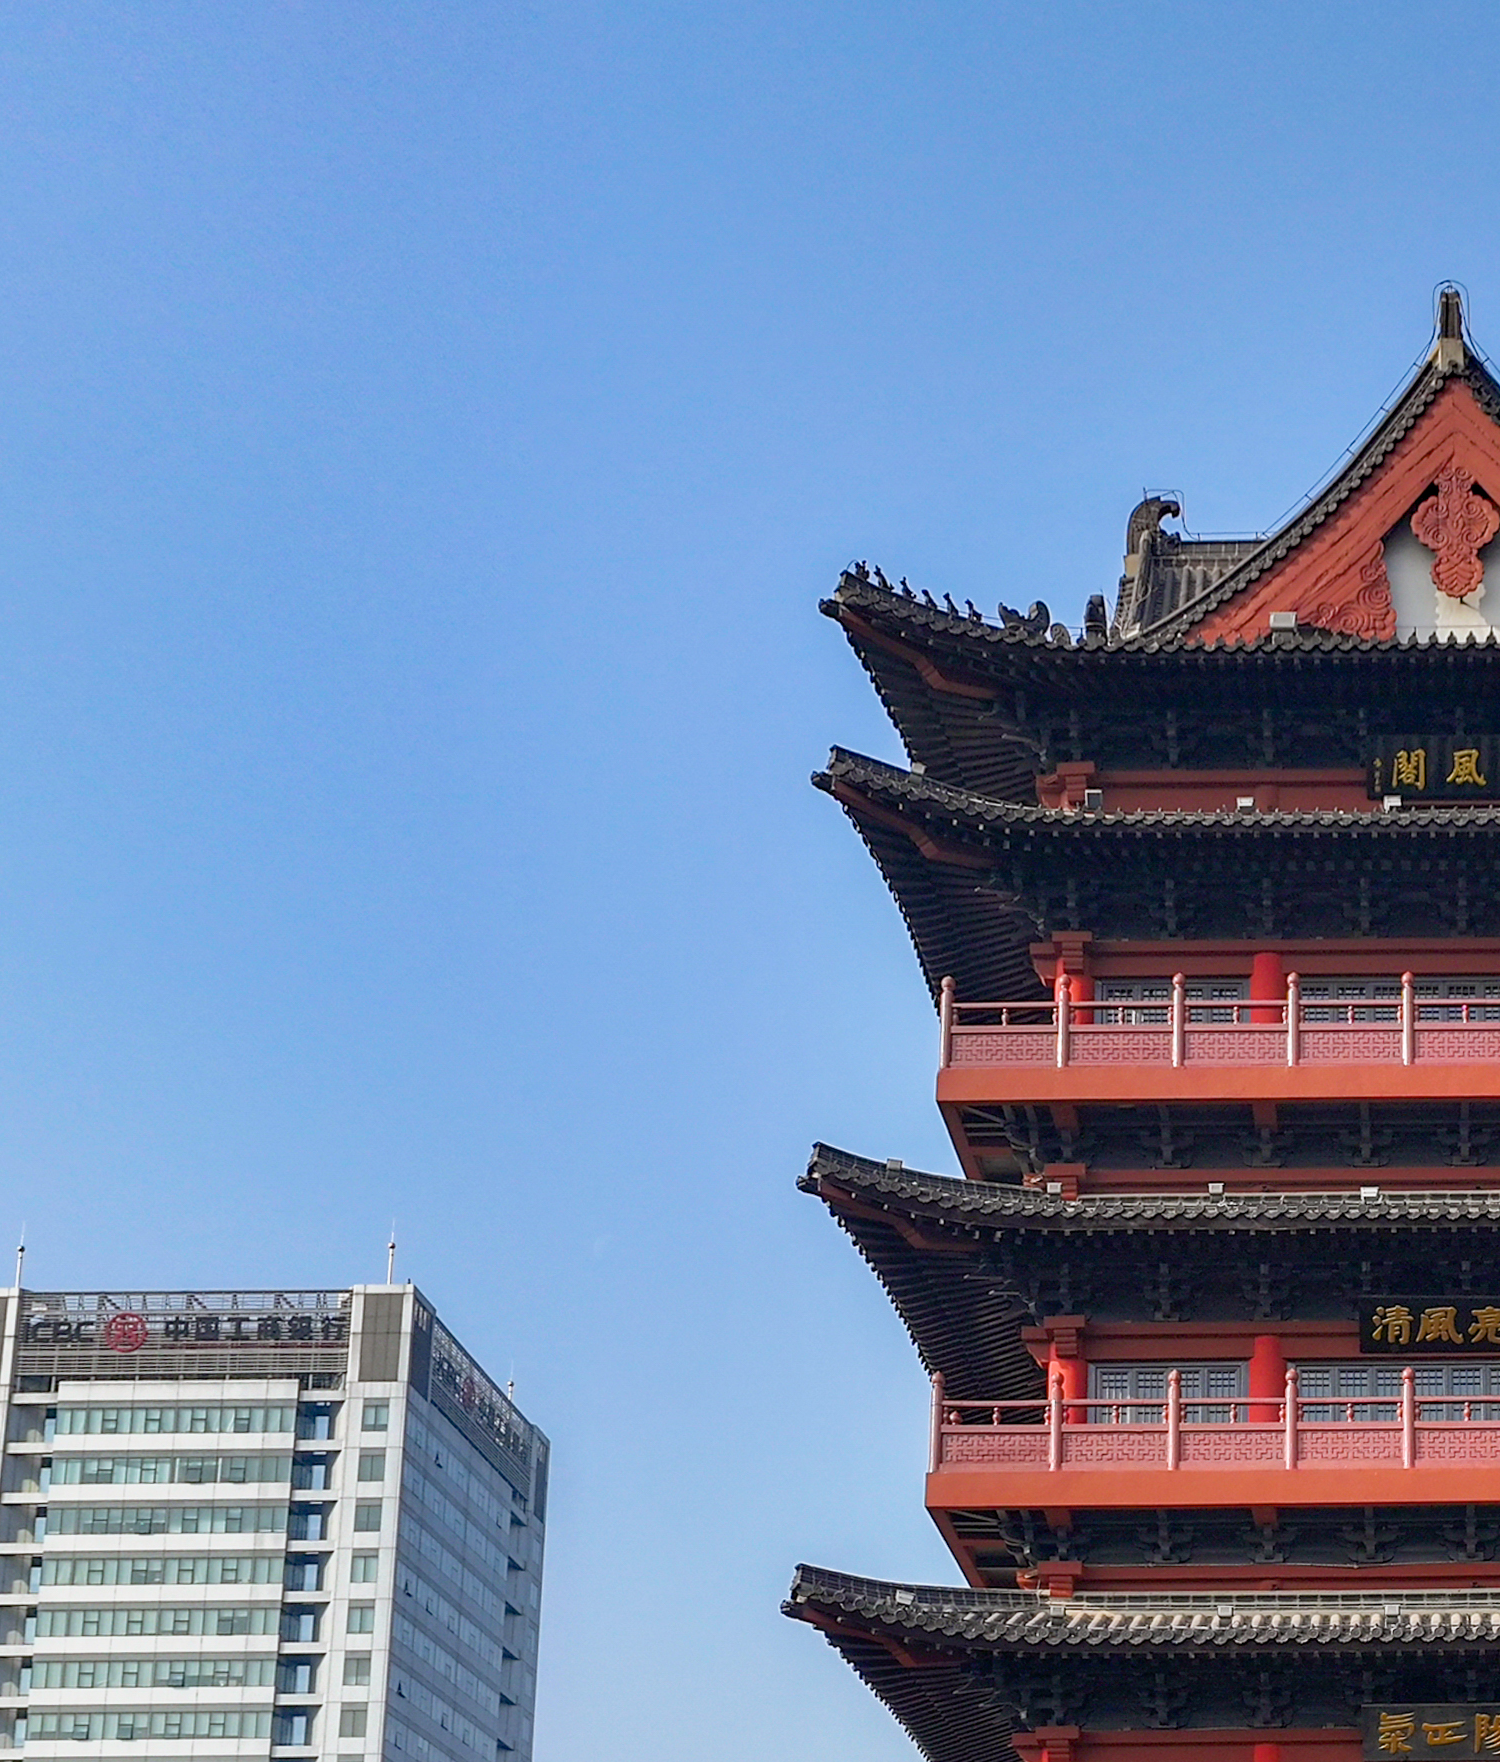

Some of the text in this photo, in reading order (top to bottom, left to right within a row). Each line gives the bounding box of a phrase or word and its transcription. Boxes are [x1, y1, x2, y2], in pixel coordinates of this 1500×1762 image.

[23, 1316, 346, 1343] ICBC 中国工商银行
